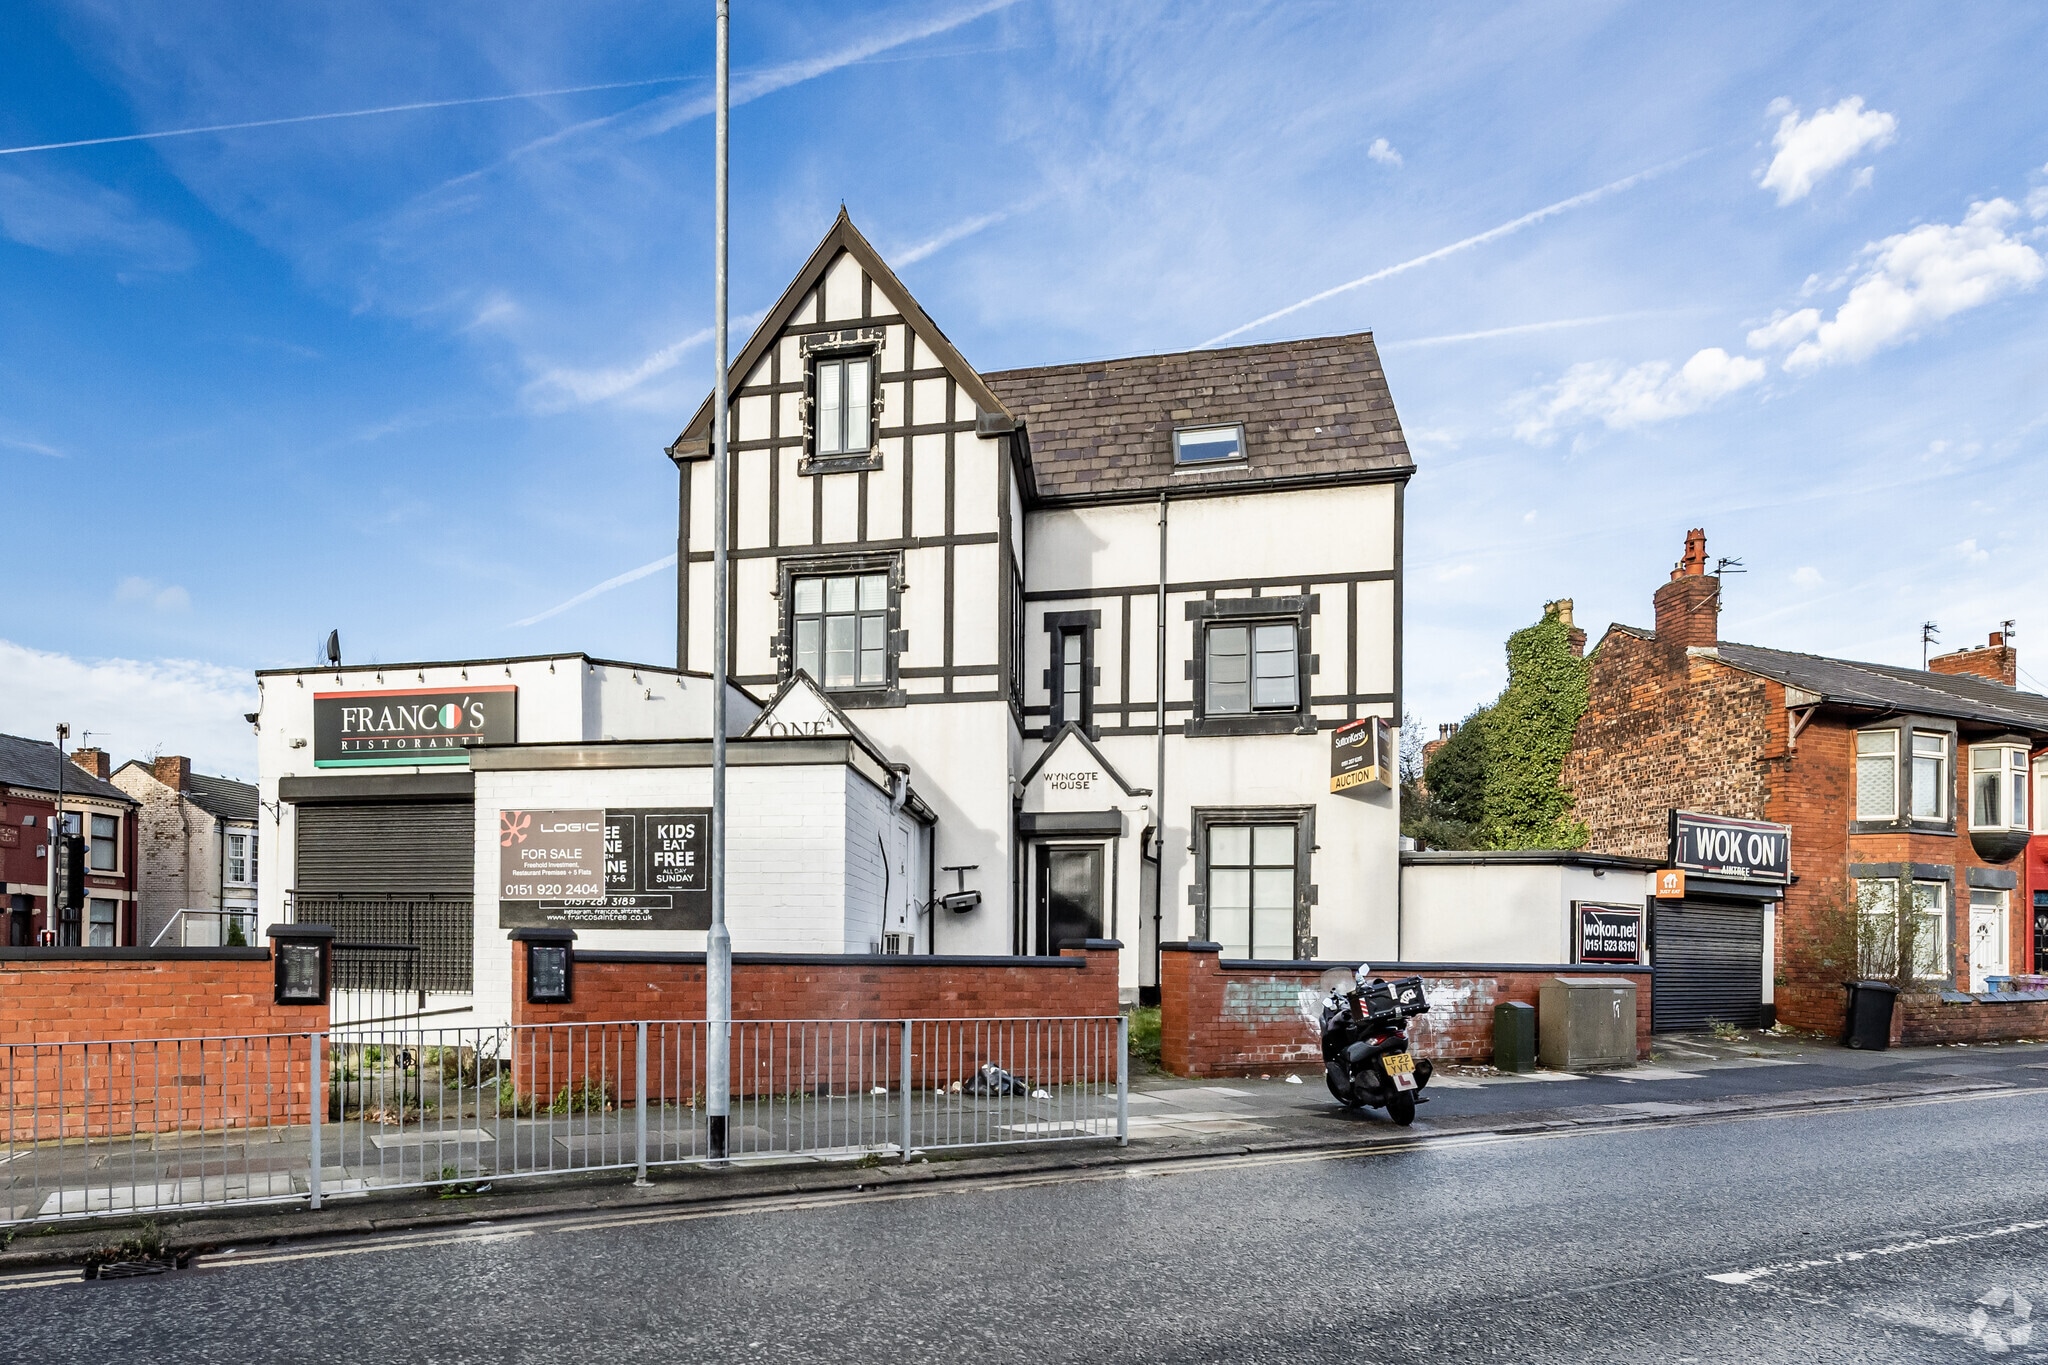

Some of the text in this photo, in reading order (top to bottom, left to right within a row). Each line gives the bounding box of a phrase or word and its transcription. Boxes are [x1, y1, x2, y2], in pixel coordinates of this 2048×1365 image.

[341, 696, 485, 733] FRANCO'S
[770, 721, 826, 736] ONE
[341, 737, 485, 751] RISTORANTE
[1043, 772, 1098, 781] WYNCOTE
[1335, 769, 1370, 789] AUCTION
[1051, 781, 1090, 790] HOUSE
[604, 826, 620, 839] EE
[657, 824, 696, 839] KIDS
[663, 840, 688, 851] EAT
[1696, 827, 1775, 867] WOK ON
[521, 848, 583, 860] FOR SALE
[654, 851, 695, 867] FREE
[611, 874, 627, 883] 3-6
[656, 874, 694, 883] SUNDAY
[505, 883, 599, 895] 0151 920 2404
[611, 897, 636, 906] 3189
[1584, 920, 1637, 939] wokon.net
[1585, 939, 1636, 952] 0151 523 8319
[1385, 1055, 1410, 1066] LF22
[1391, 1064, 1409, 1074] YVT
[1397, 1076, 1411, 1086] L
